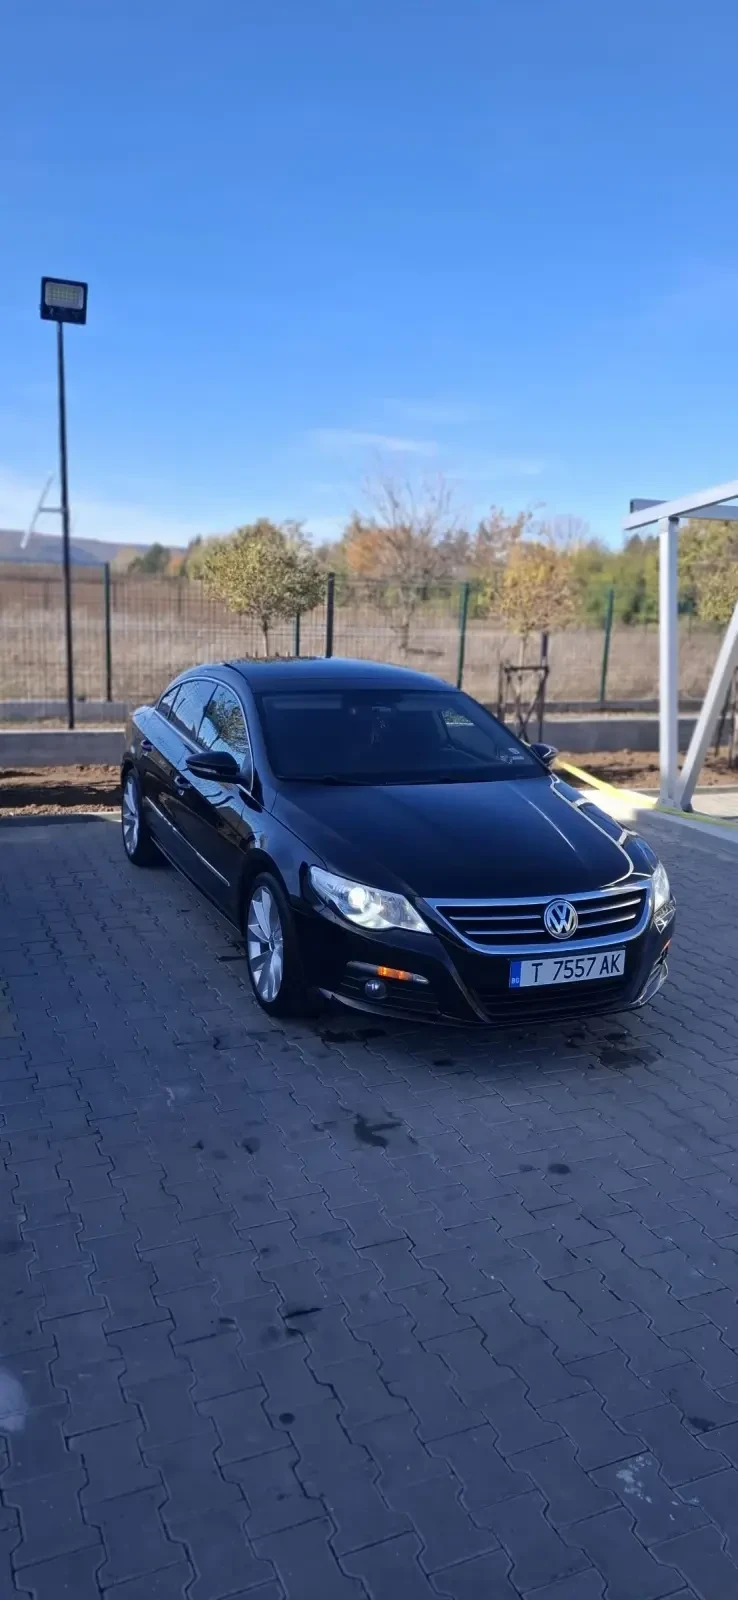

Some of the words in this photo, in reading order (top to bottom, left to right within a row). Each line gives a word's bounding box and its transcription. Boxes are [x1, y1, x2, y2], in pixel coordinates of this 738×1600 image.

[546, 901, 577, 936] VW
[531, 962, 543, 983] T
[552, 957, 597, 981] 7557
[599, 953, 621, 976] AK
